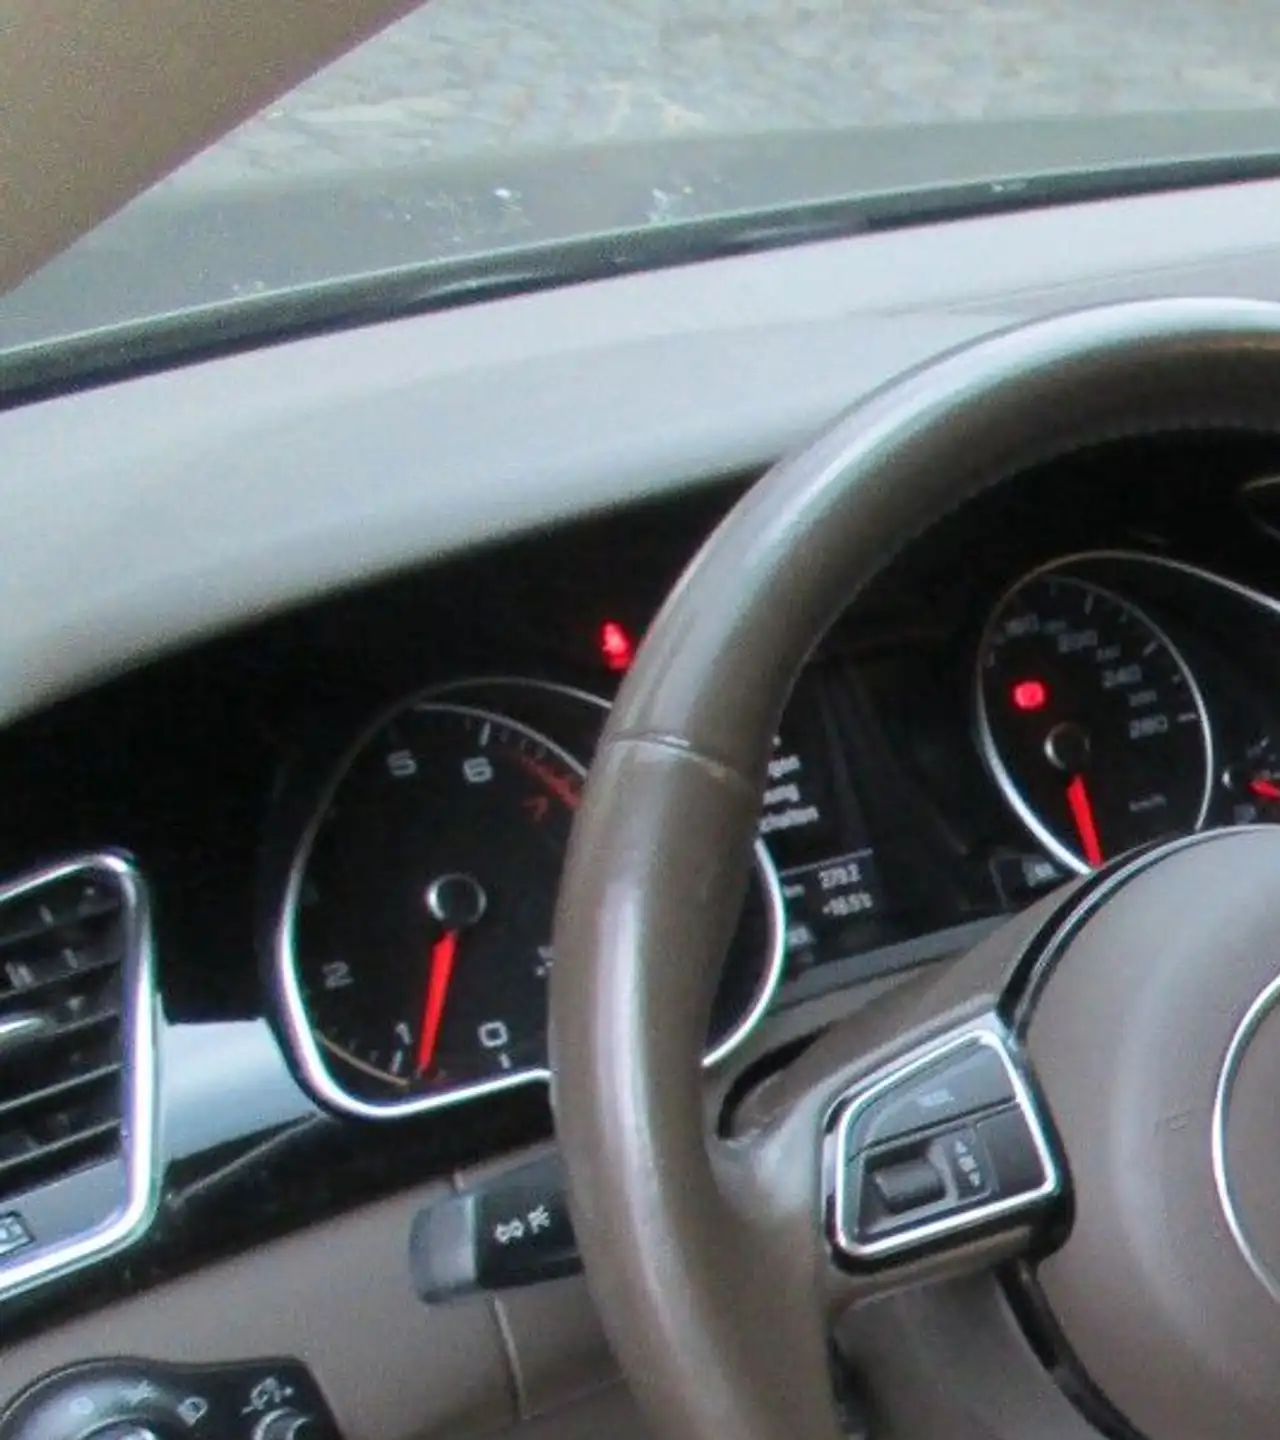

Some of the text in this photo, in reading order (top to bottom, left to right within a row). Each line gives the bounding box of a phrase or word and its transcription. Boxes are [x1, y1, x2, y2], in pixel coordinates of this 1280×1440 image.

[388, 750, 417, 776] 5
[463, 757, 494, 783] 6
[322, 961, 352, 988] 2
[394, 1021, 411, 1045] 1
[477, 1020, 508, 1047] 0
